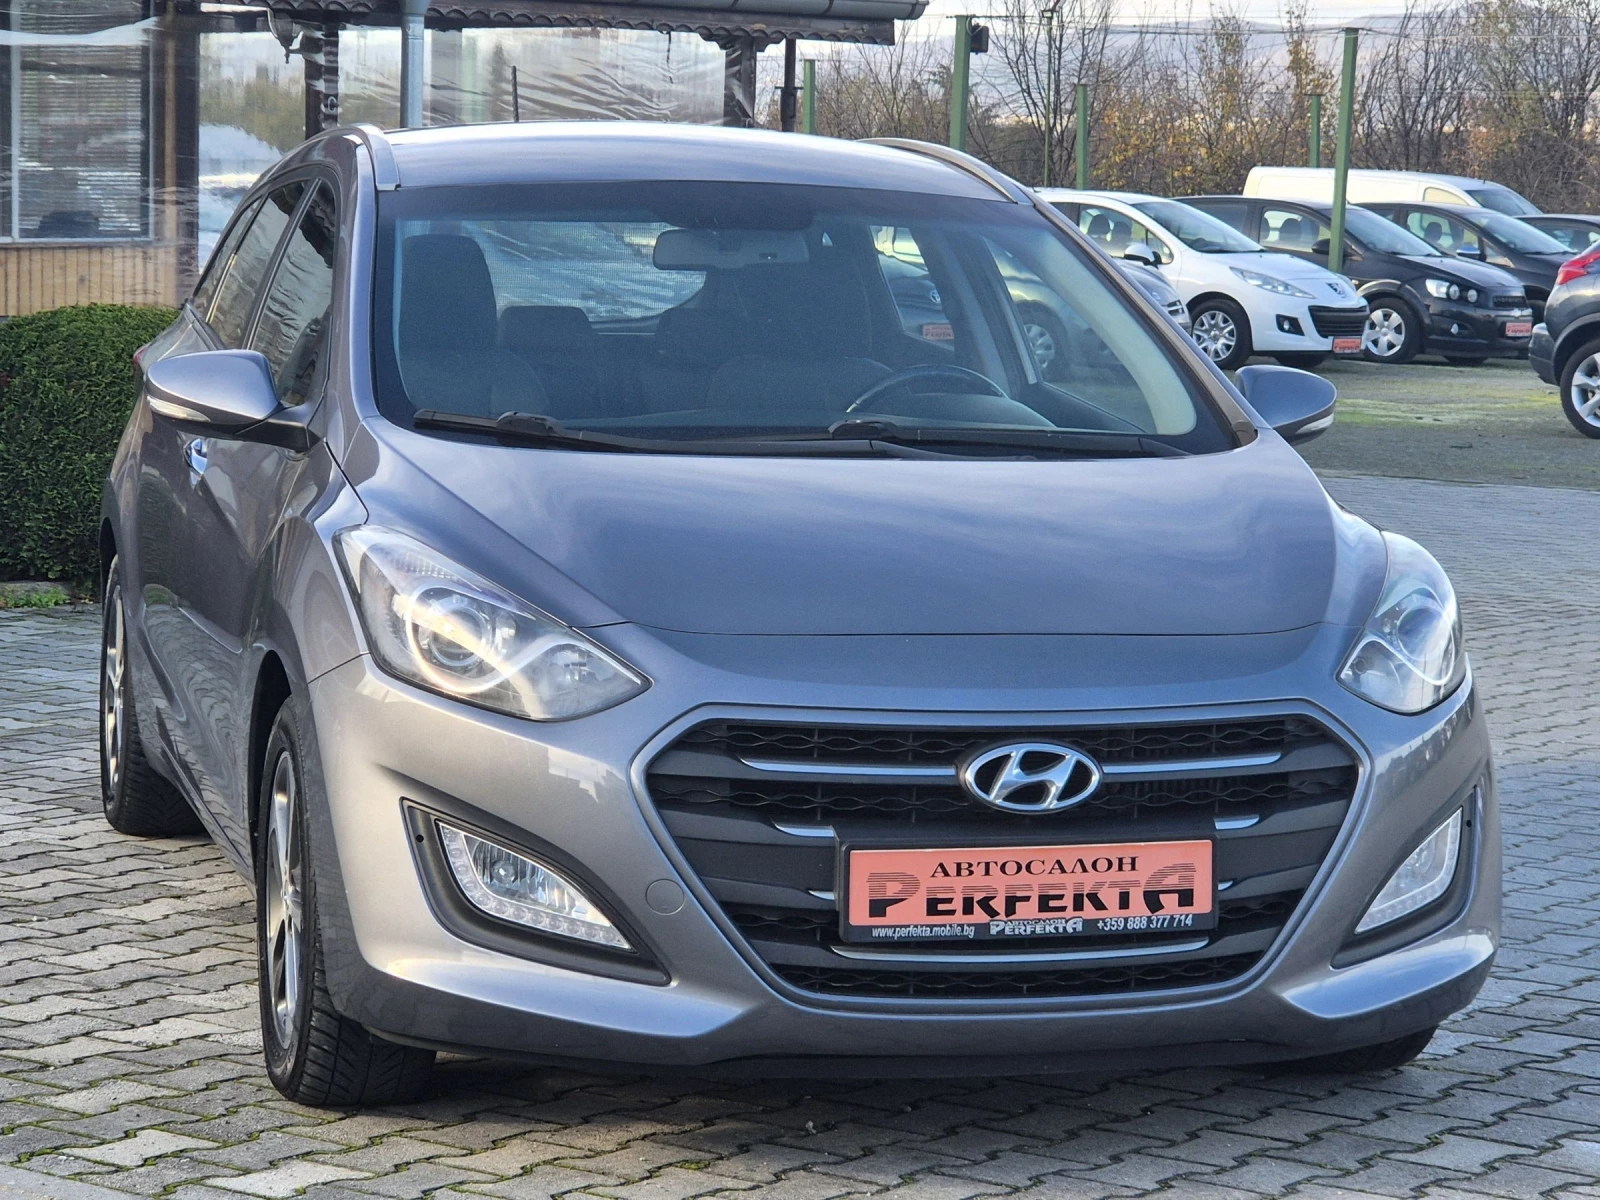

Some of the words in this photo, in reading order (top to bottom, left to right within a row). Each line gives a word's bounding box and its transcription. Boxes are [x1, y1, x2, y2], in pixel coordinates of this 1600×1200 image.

[930, 856, 1140, 878] АВТОСАЛОН
[866, 862, 1197, 919] PERFEKTA
[871, 924, 975, 940] www.perfekta.mobile.bg
[989, 917, 1084, 936] PERFEKTA
[1097, 918, 1125, 931] +359
[1127, 916, 1147, 930] 888
[1150, 915, 1171, 929] 377
[1173, 914, 1193, 927] 714
